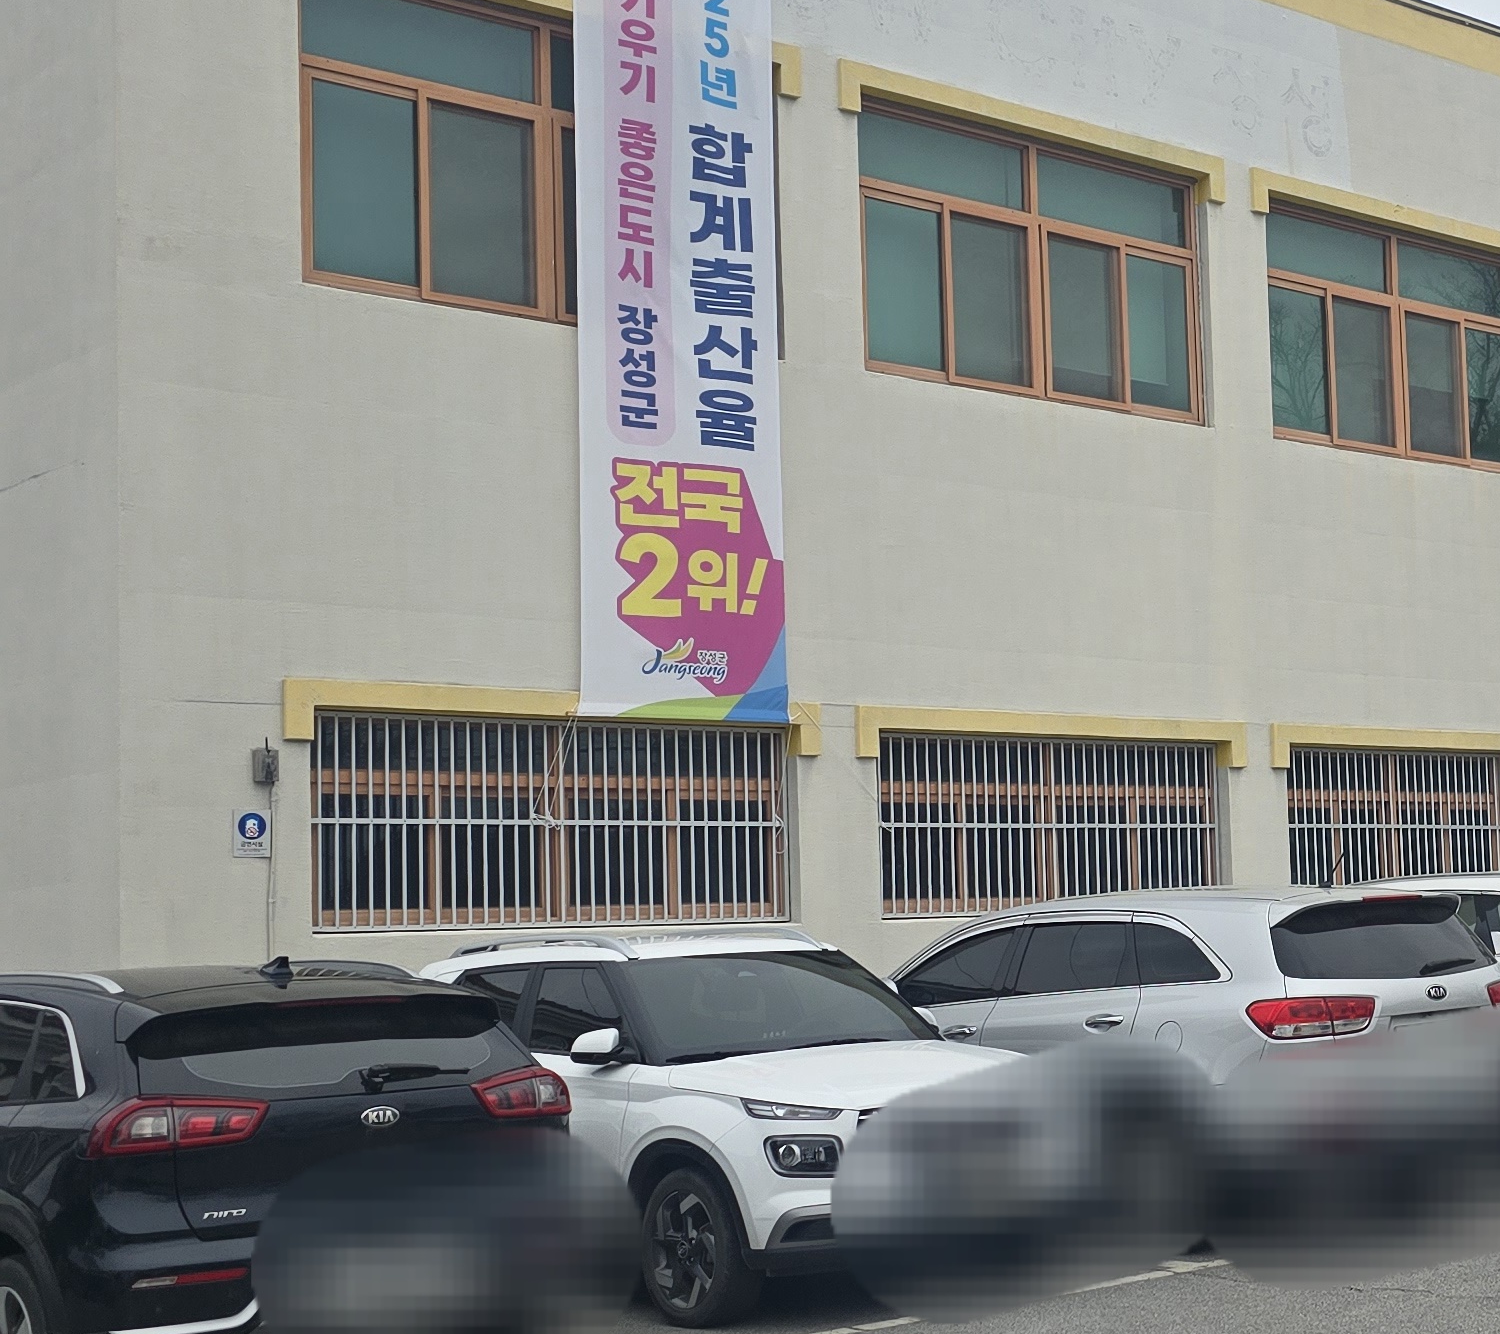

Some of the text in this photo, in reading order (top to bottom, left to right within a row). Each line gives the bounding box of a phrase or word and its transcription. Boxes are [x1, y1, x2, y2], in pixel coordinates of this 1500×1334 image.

[689, 123, 757, 451] 합계출산율
[617, 304, 659, 430] 장성군
[615, 463, 743, 533] 전국
[619, 532, 768, 617] 2위!
[642, 647, 728, 683] Jangseong
[699, 650, 727, 664] 장성군
[1430, 987, 1446, 997] KIA
[368, 1110, 395, 1124] KIA
